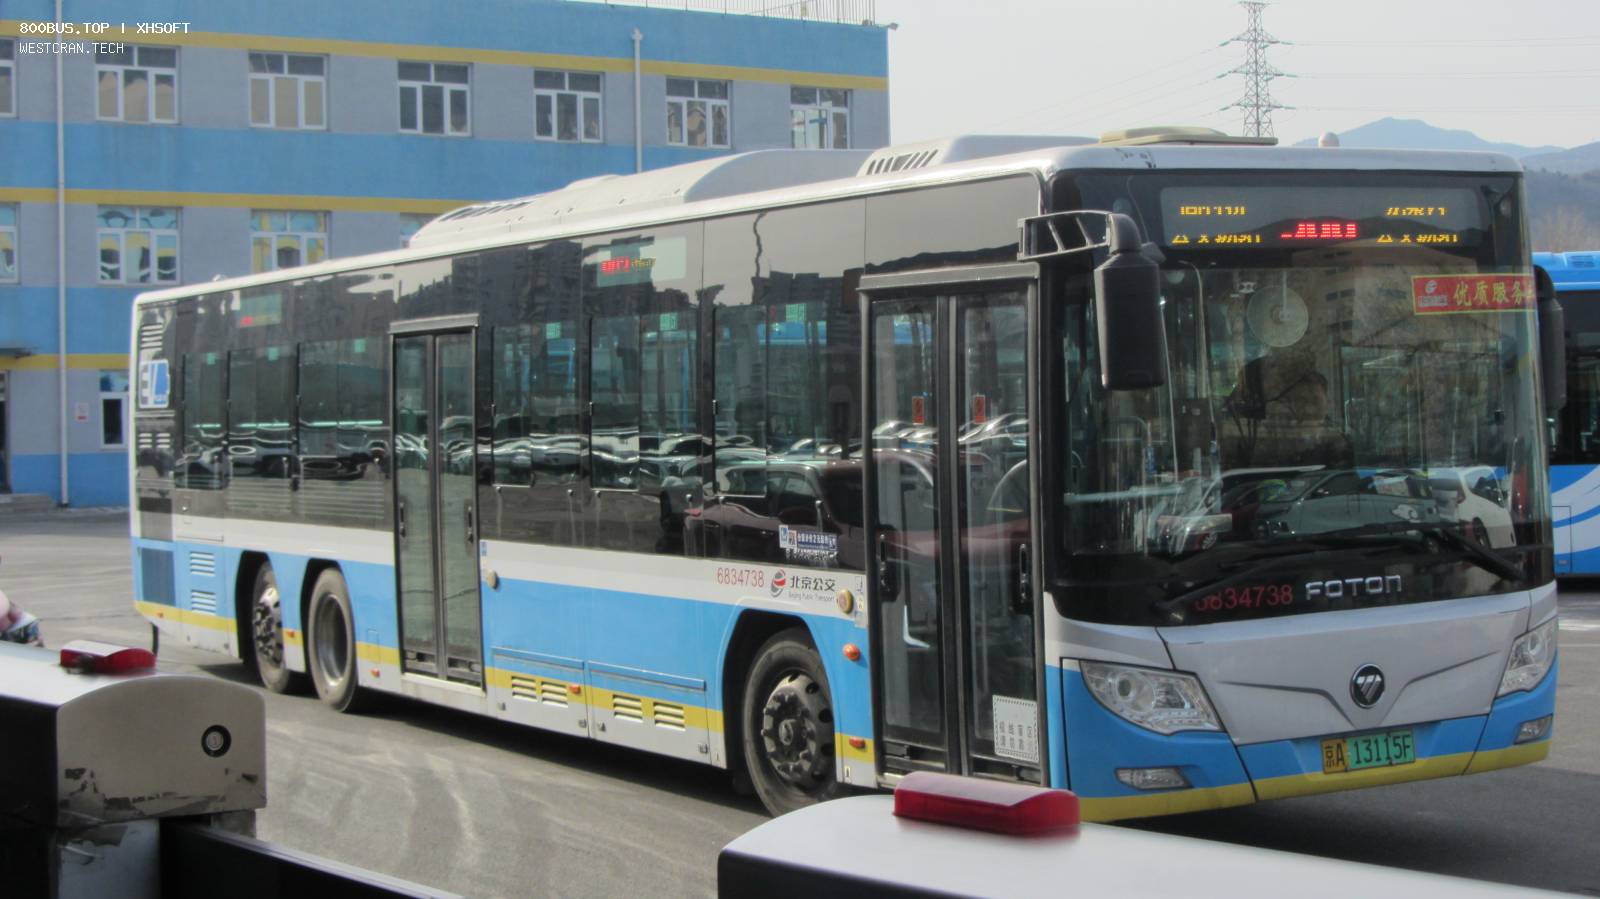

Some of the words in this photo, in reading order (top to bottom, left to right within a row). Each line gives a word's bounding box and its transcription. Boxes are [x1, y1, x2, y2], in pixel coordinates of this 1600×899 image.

[717, 567, 765, 588] 6834738
[790, 575, 836, 592] 北京公交
[1305, 575, 1402, 600] FOTON
[1354, 735, 1411, 764] 13115F
